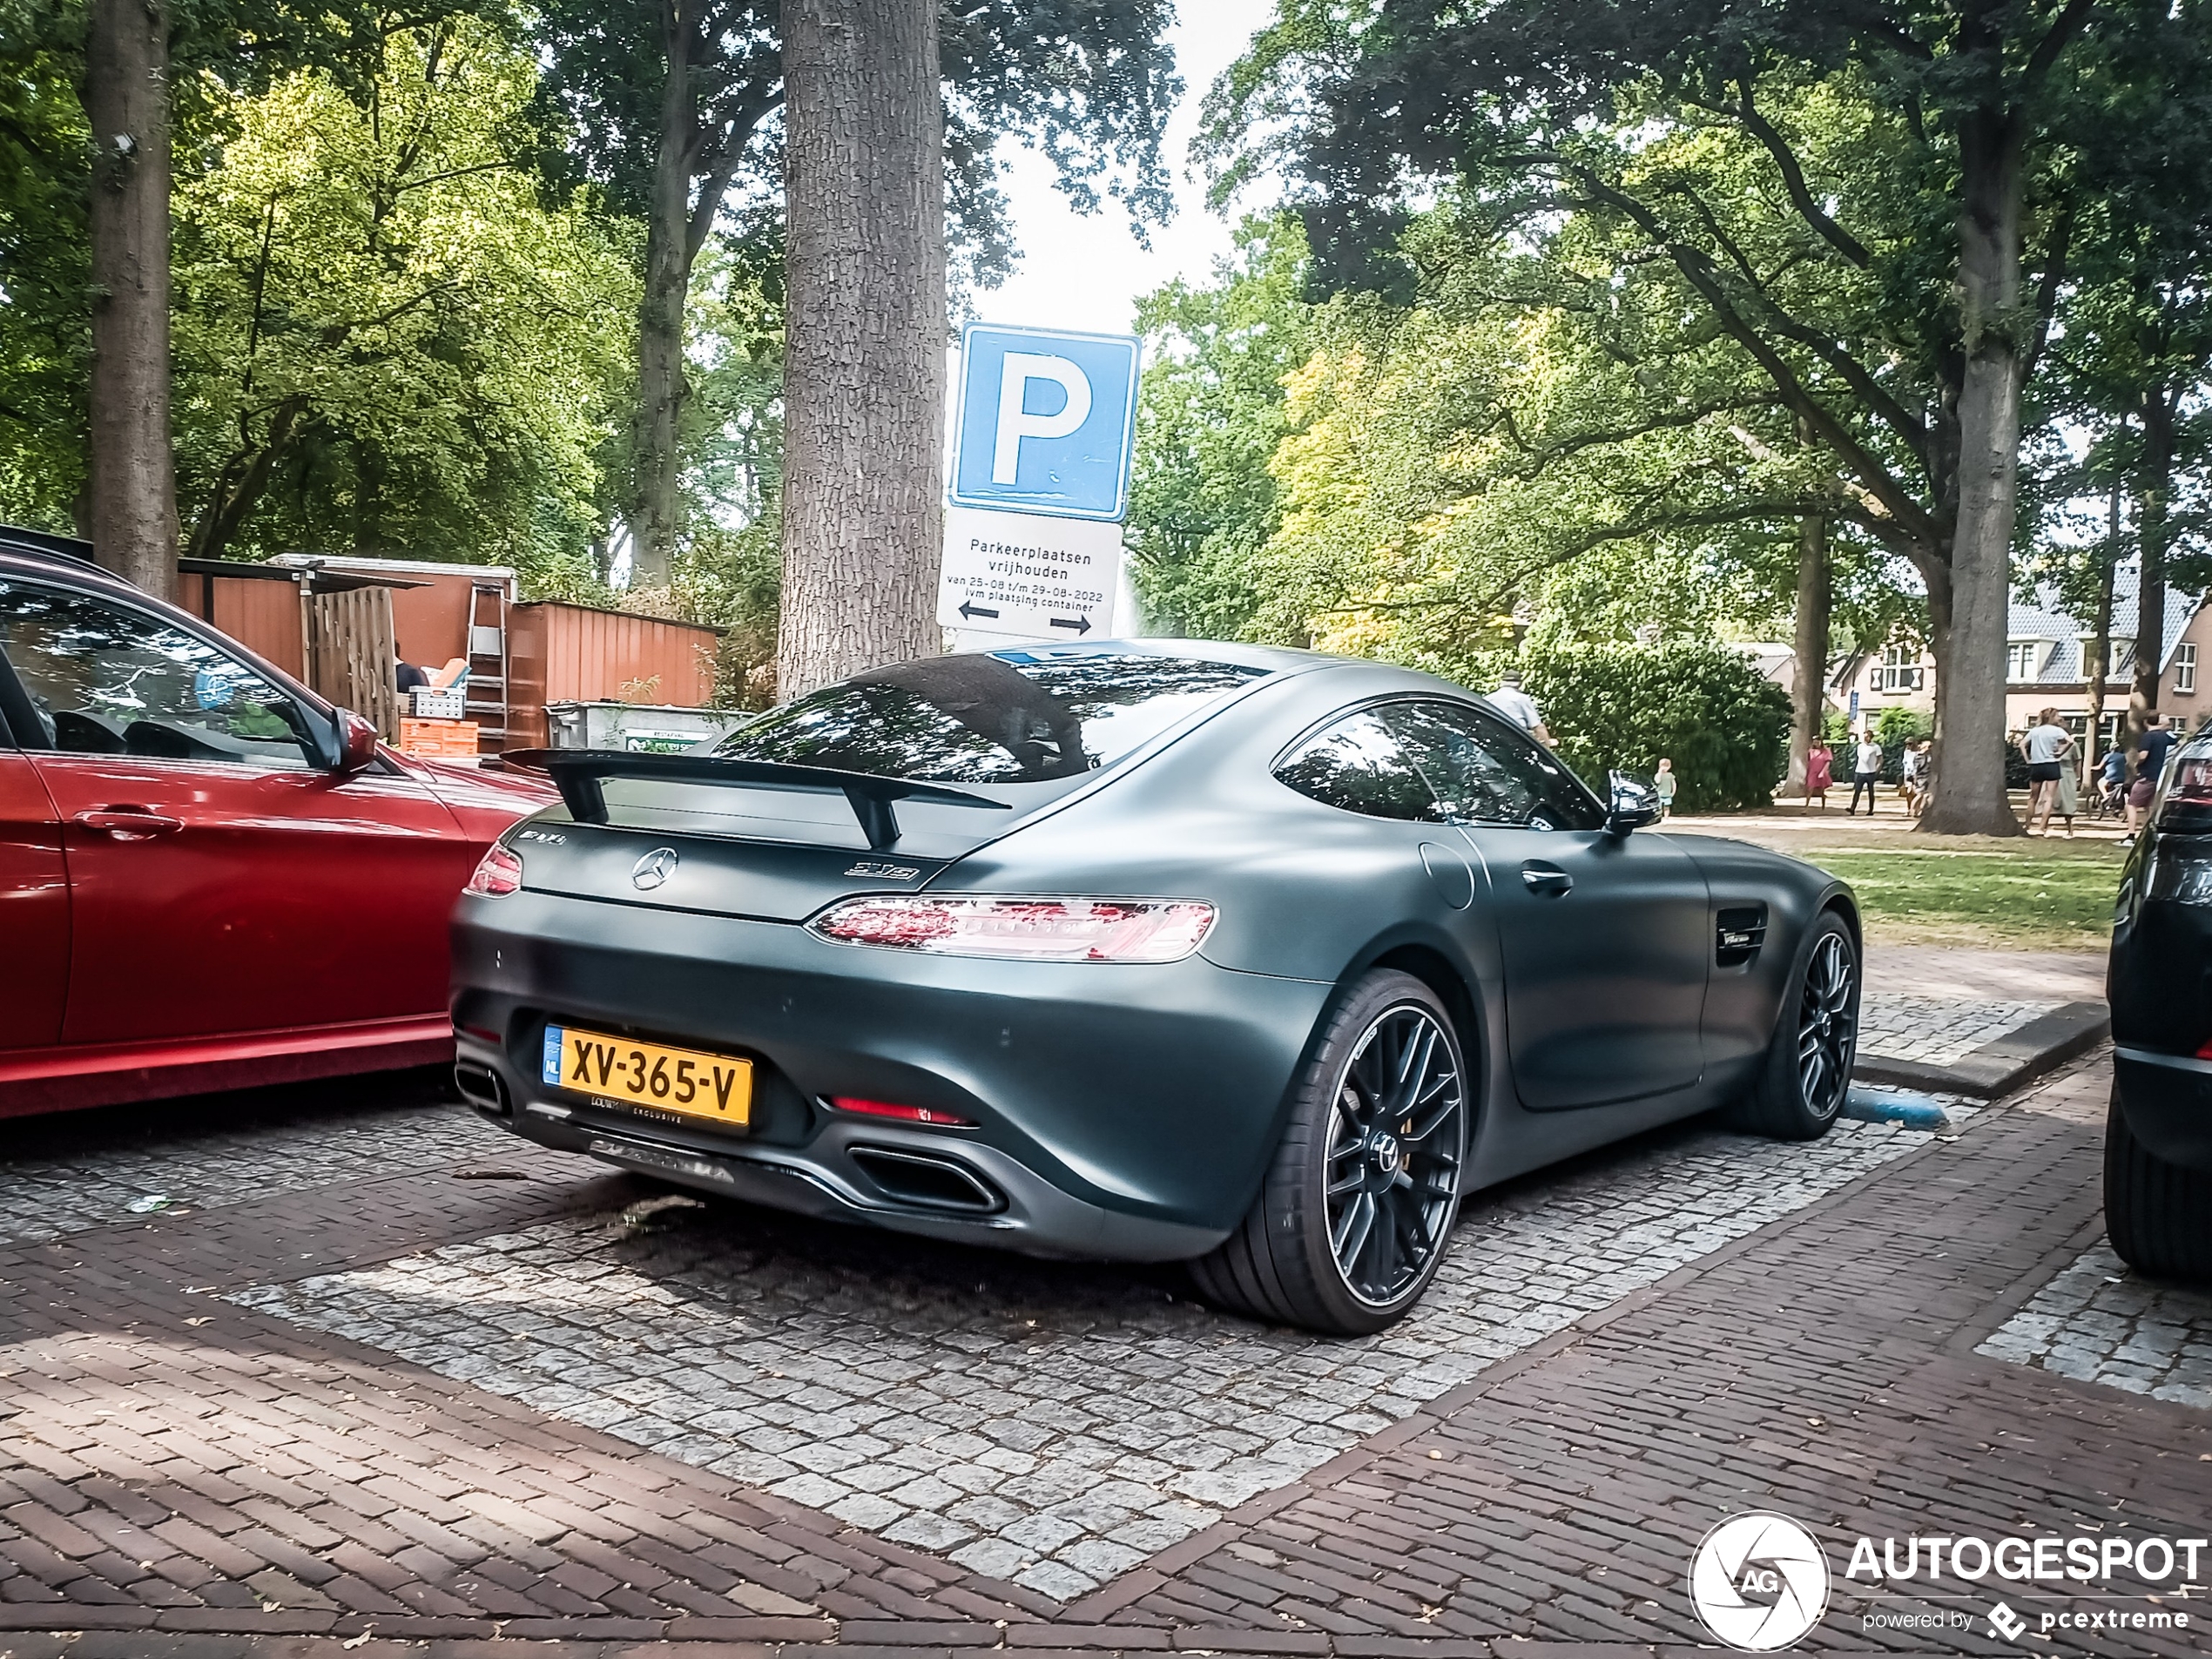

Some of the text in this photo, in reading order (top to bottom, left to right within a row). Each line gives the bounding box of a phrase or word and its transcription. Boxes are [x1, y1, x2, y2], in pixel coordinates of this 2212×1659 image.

[991, 351, 1093, 486] P
[970, 538, 1091, 565] Parkeerplaatsen
[988, 560, 1068, 580] vrijhouden
[947, 576, 1103, 603] van 25-08 t/m 29-08-2022
[988, 590, 1039, 608] plaatsing
[1041, 598, 1094, 612] container
[571, 1039, 736, 1111] XV-365-V
[633, 1107, 682, 1124] EXCLUSIVE
